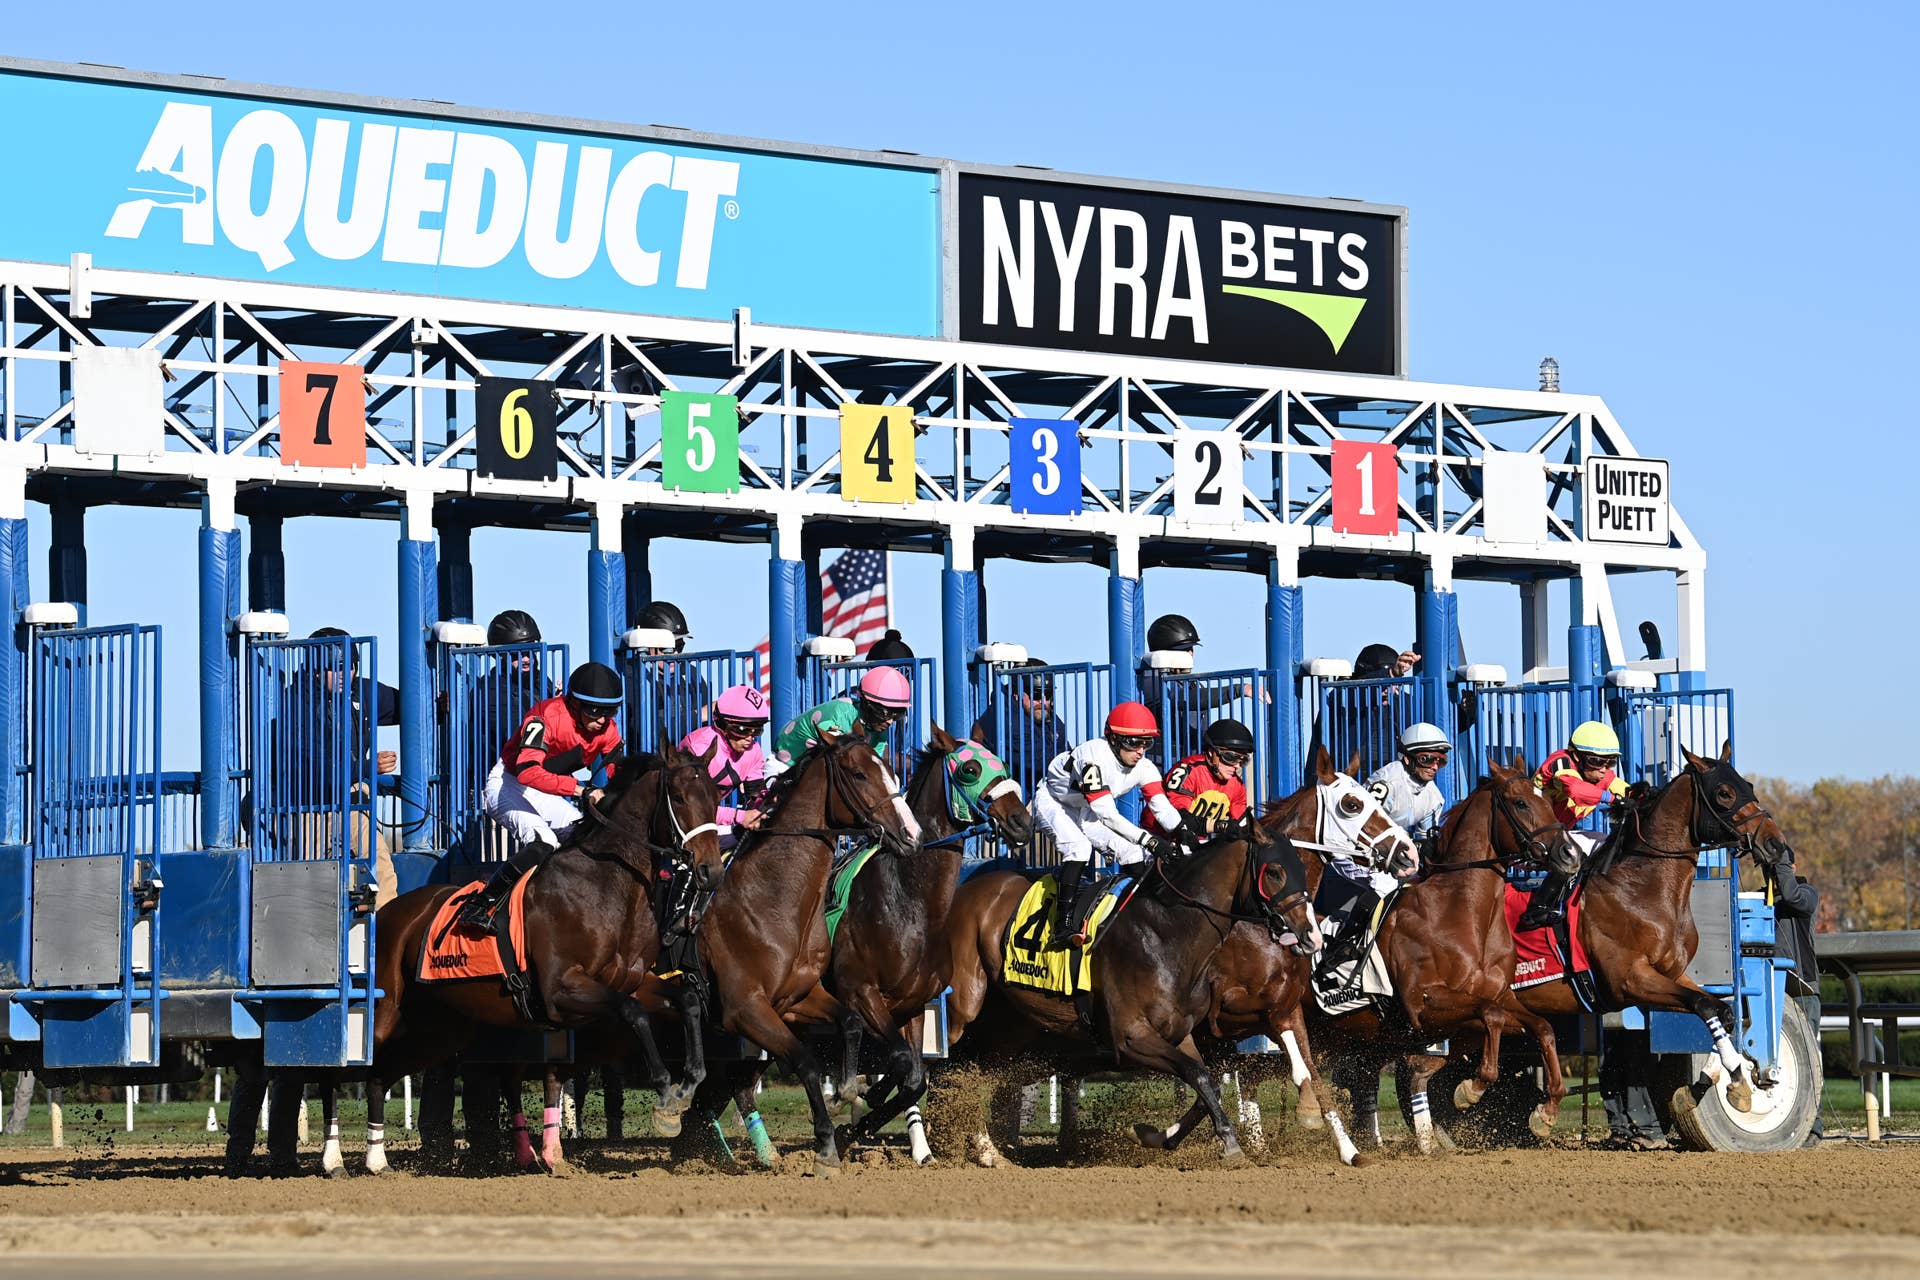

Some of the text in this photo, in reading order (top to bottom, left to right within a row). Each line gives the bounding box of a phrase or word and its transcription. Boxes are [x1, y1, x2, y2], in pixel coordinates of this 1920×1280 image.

[104, 101, 740, 290] AQUEDUCT
[982, 195, 1370, 346] NYRA BETS
[306, 374, 338, 445] 7
[501, 388, 534, 460] 6
[686, 402, 716, 473] 5
[864, 416, 894, 482] 4
[1031, 427, 1061, 496] 3
[1194, 440, 1222, 506] 2
[1595, 463, 1662, 498] UNITED
[1355, 451, 1376, 516] 1
[1598, 499, 1656, 532] PUETT
[525, 722, 544, 746] 7
[1083, 765, 1102, 791] 4
[1167, 767, 1186, 790] 3
[429, 951, 469, 969] AQUEDUCT
[1013, 897, 1054, 961] 4
[1007, 959, 1050, 980] AQUEDUCT
